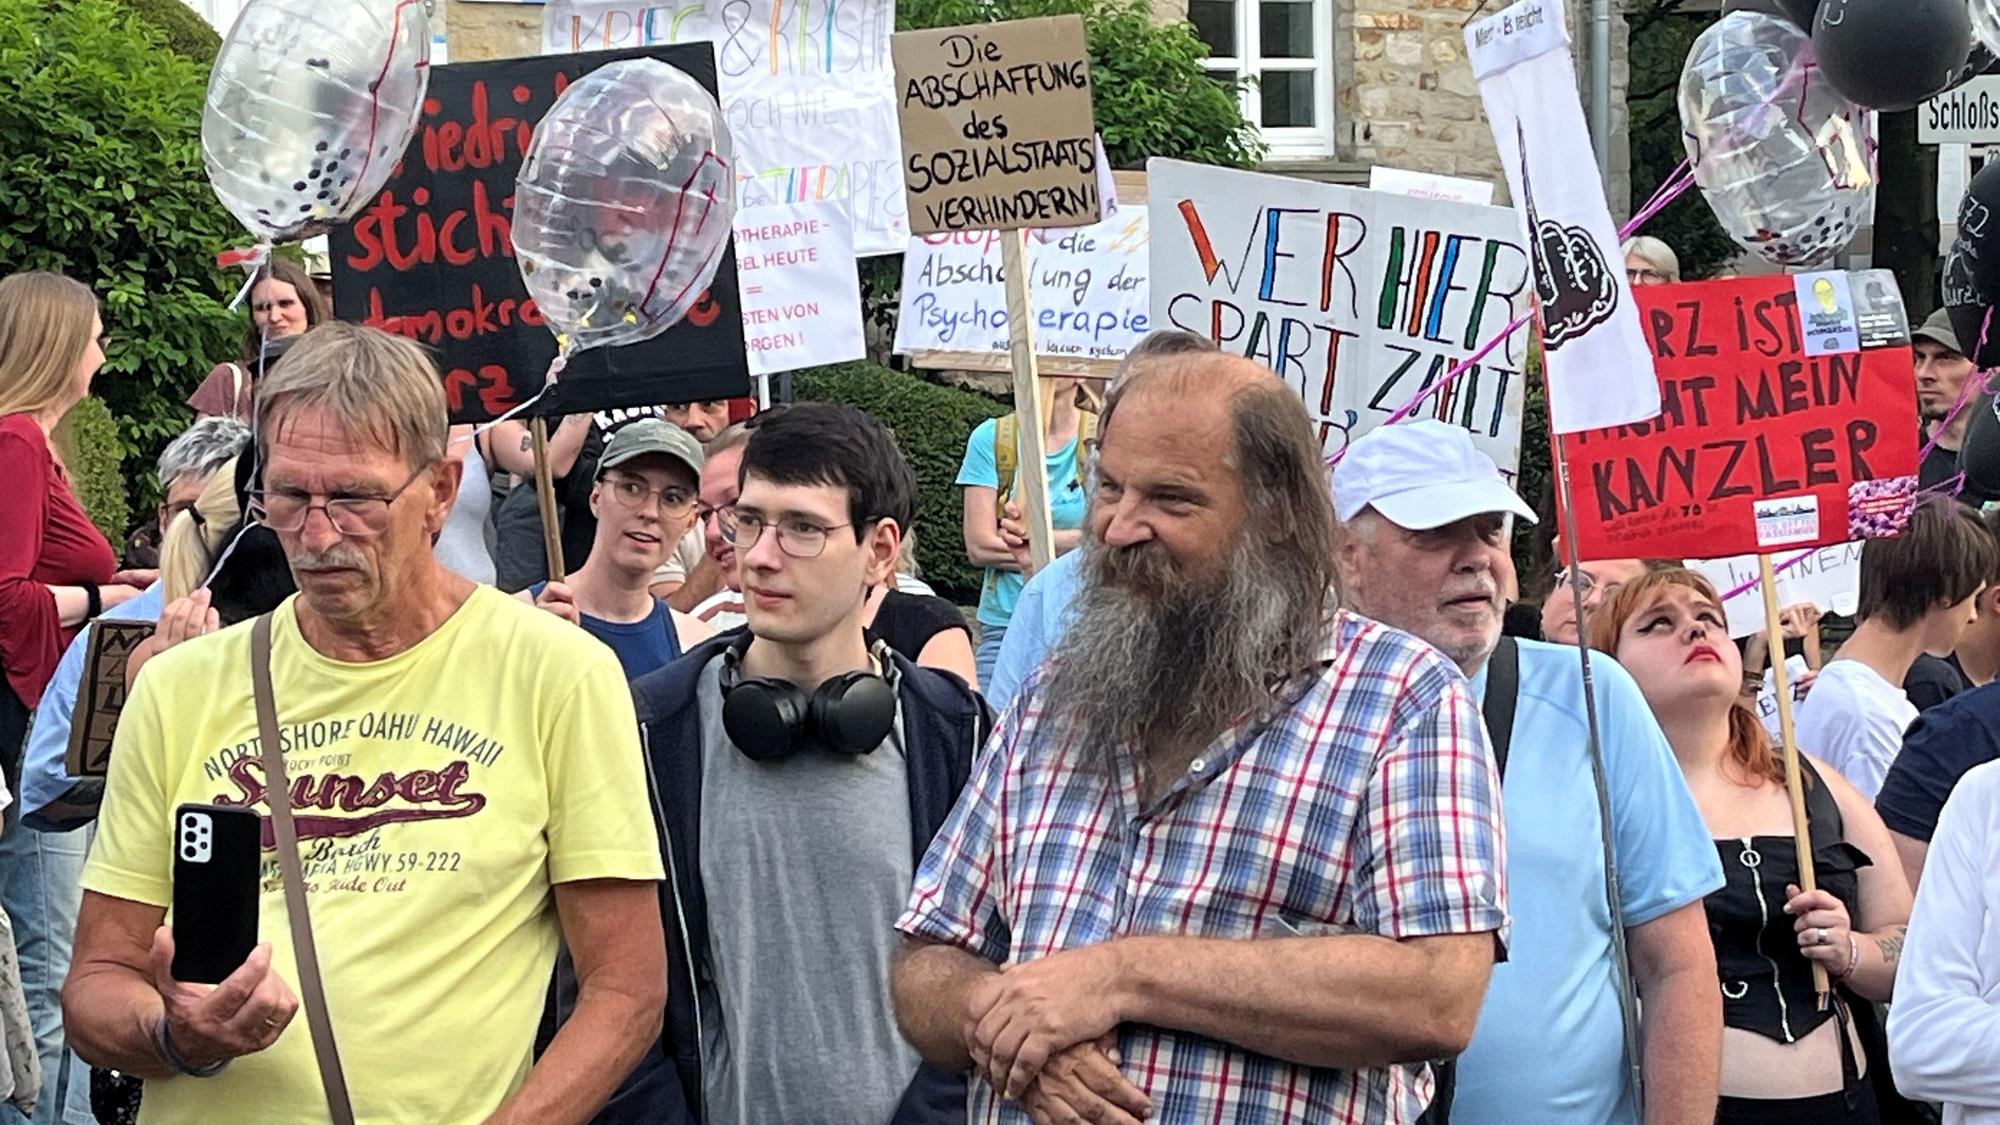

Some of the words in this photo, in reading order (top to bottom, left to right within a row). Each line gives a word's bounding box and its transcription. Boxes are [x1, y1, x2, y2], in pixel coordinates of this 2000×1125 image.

[719, 0, 763, 77] &
[939, 34, 1002, 68] Die
[904, 60, 1088, 109] ABSCHAFFUNG
[962, 110, 1009, 140] des
[907, 137, 1096, 194] SOZIALSTAATS
[346, 179, 516, 272] stich
[925, 182, 1100, 230] VERHINDERN!
[763, 247, 818, 268] HEUTE
[1058, 232, 1096, 253] die
[1177, 199, 1368, 319] WER
[1107, 262, 1146, 292] der
[1377, 226, 1530, 367] HIER
[782, 302, 820, 320] VON
[1591, 419, 1878, 522] KANZLER
[203, 735, 264, 782] NORT
[278, 719, 356, 754] SHORE
[359, 712, 420, 741] OAHU
[421, 716, 504, 768] HAWAII
[212, 755, 487, 813] Sunset
[372, 878, 407, 893] Out
[395, 852, 462, 873] 59-222
